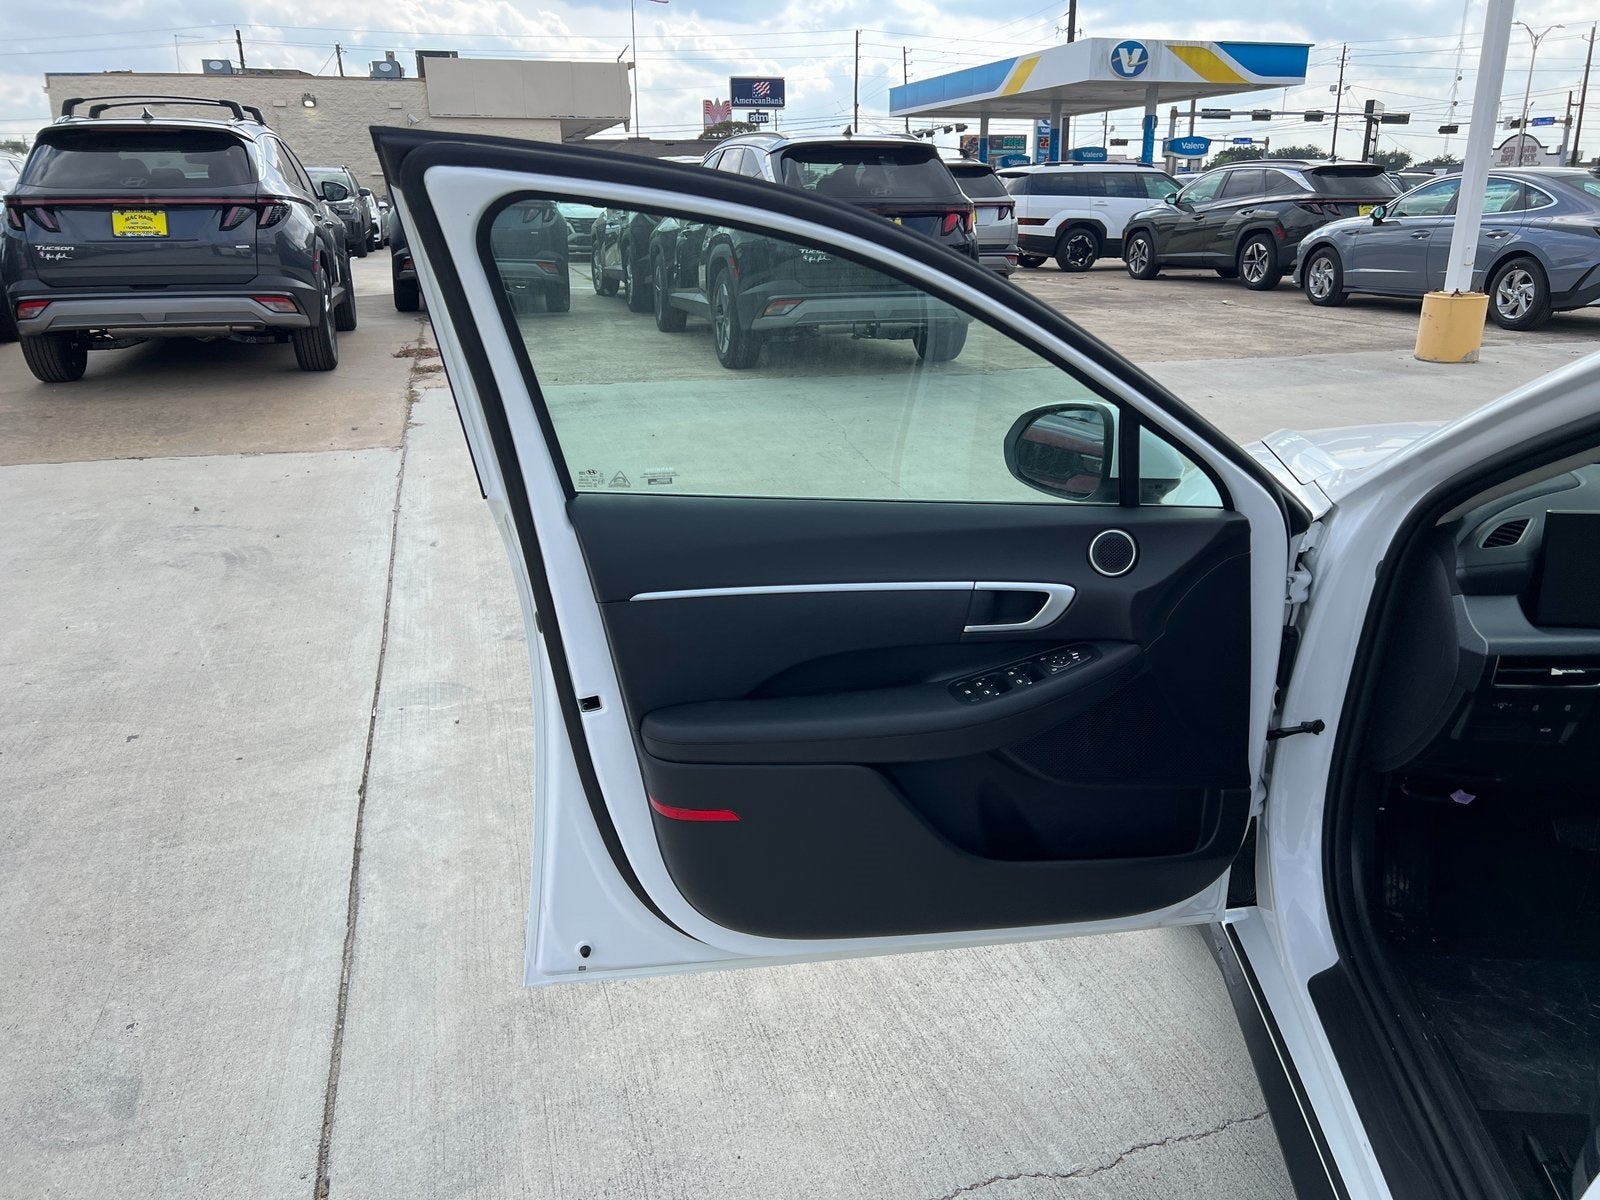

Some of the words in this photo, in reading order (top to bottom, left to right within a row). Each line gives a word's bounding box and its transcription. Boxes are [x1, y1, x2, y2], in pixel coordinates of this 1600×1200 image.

[733, 97, 784, 105] AmericanBank
[750, 114, 768, 122] atm
[1181, 142, 1205, 150] Valero
